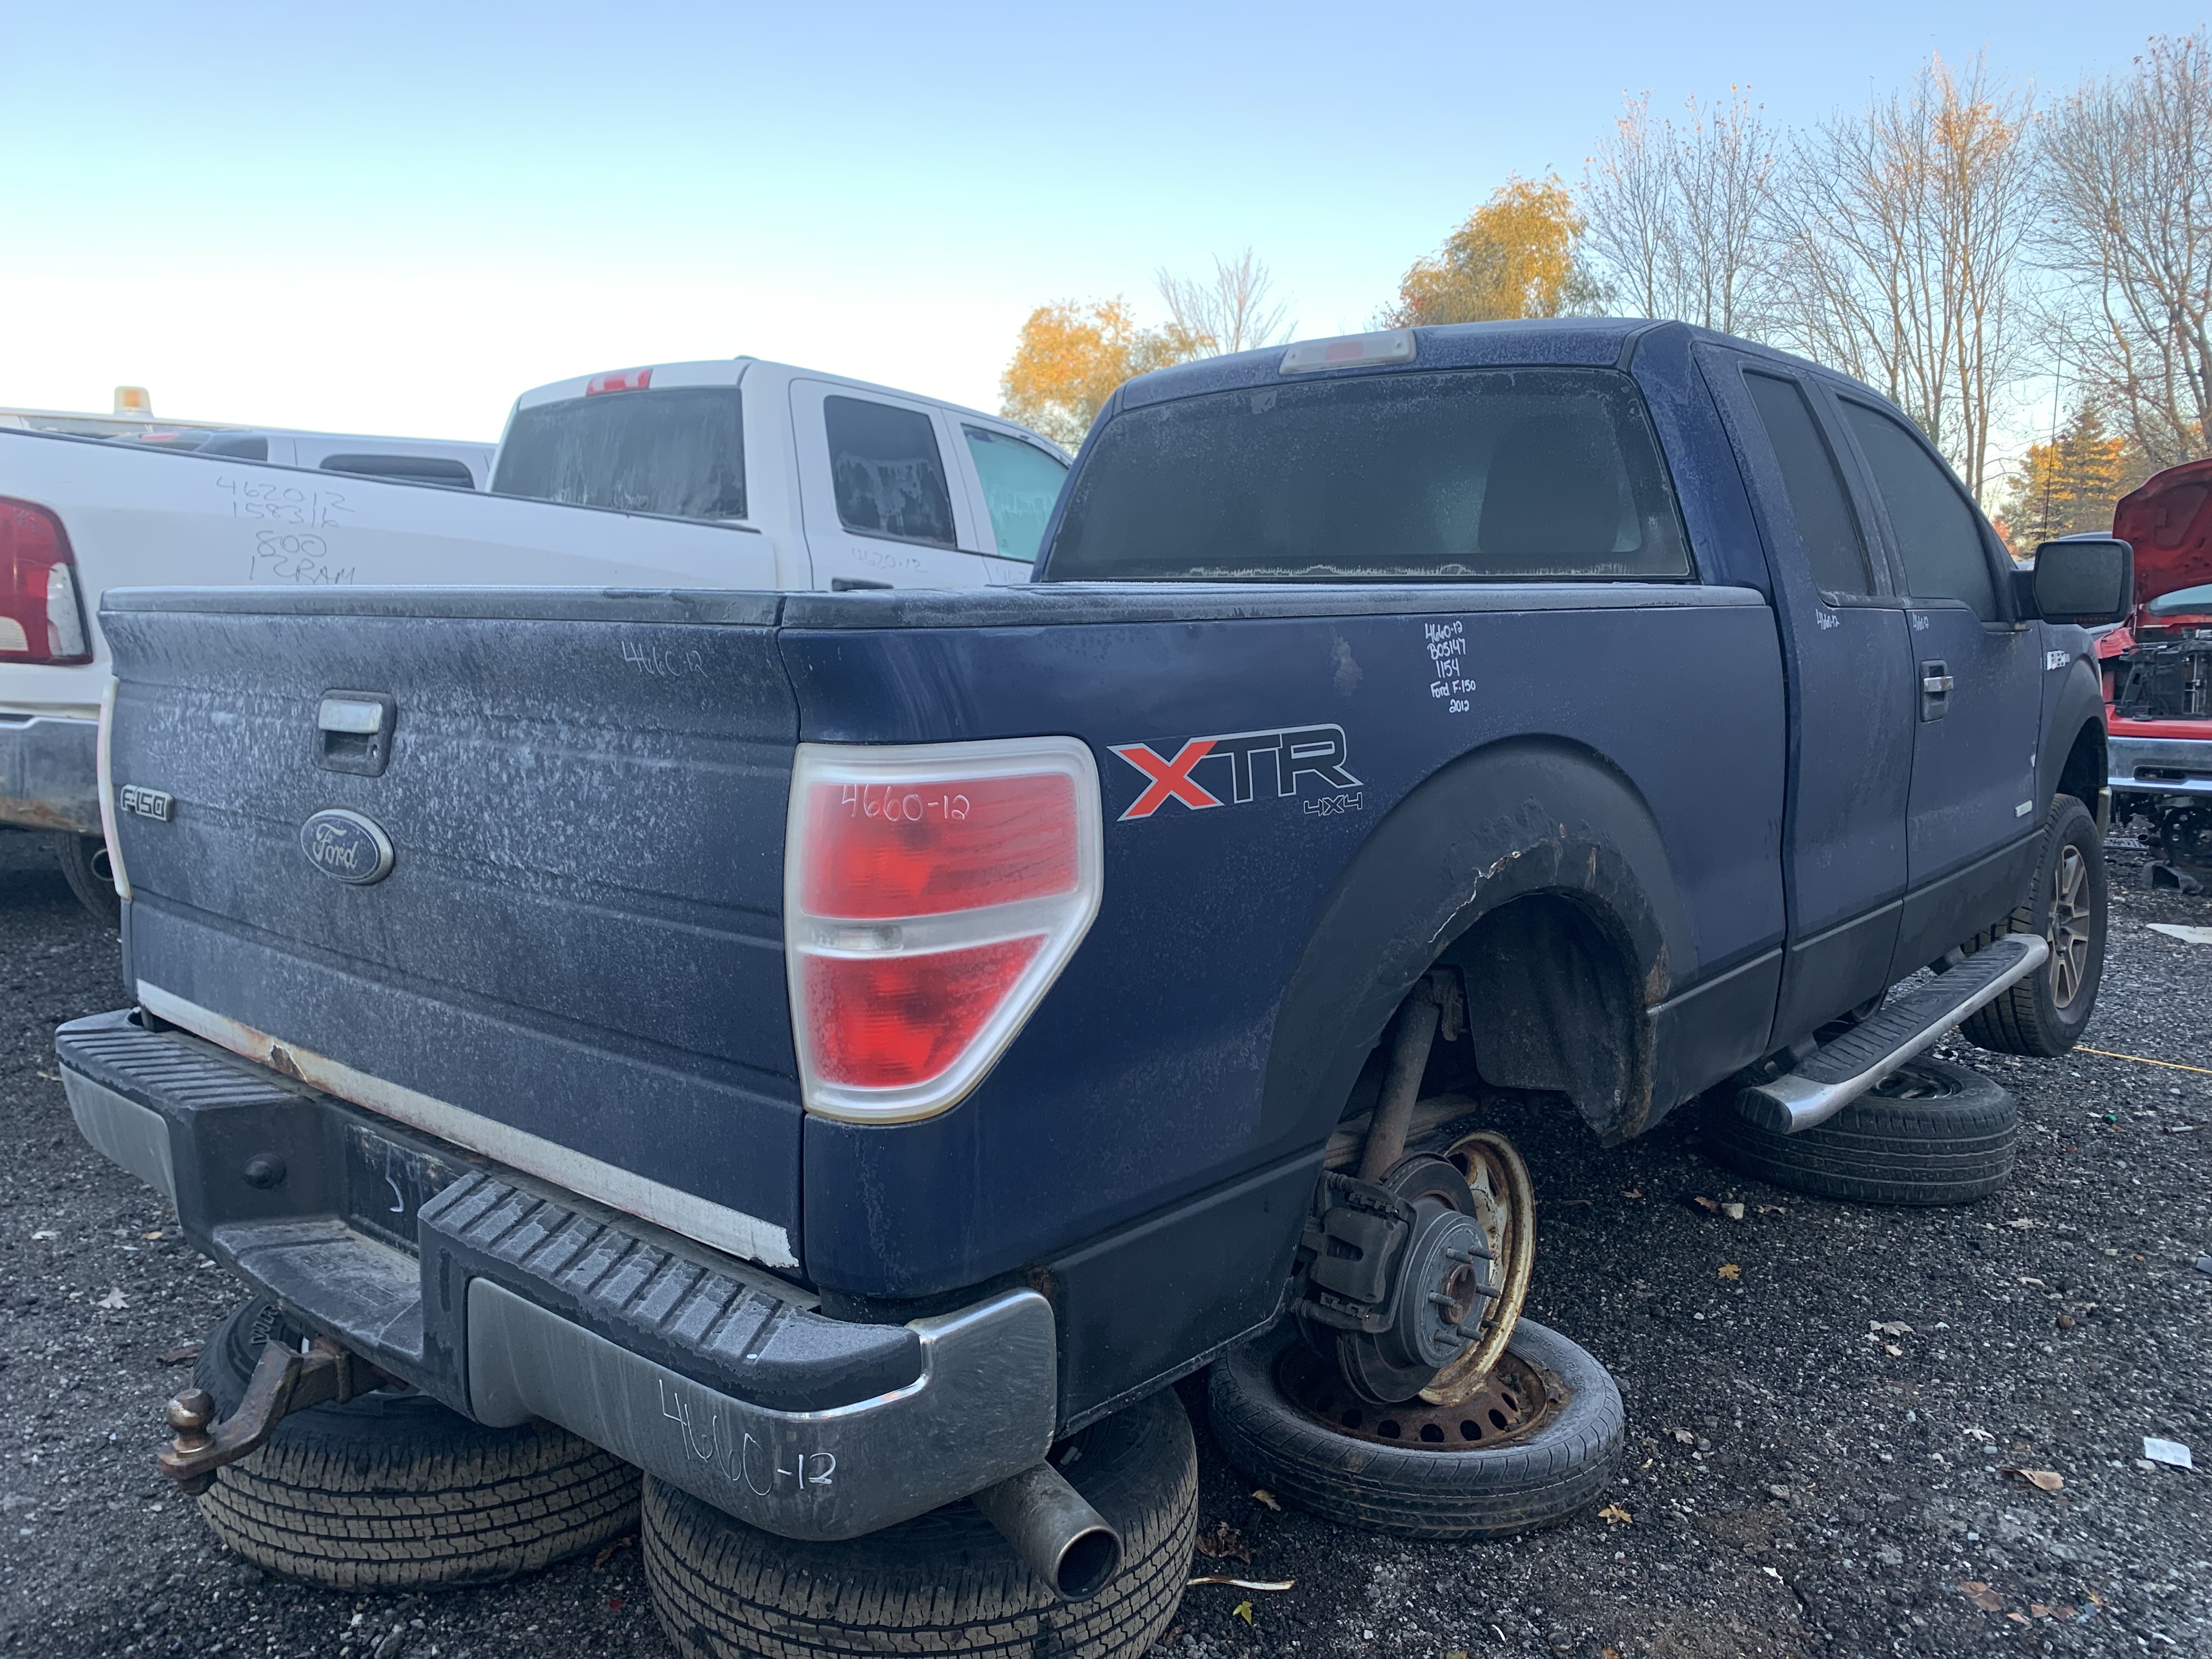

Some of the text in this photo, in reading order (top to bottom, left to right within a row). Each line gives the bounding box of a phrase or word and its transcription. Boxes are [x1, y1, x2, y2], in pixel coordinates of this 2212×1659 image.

[1436, 658, 1460, 678] 1154
[1430, 681, 1450, 698] Ford
[1449, 699, 1469, 713] 2012
[1105, 723, 1364, 821] XTR
[121, 785, 168, 821] F-150
[842, 783, 970, 821] 4660-12
[312, 822, 359, 870] Ford
[658, 1379, 837, 1496] 4660-12
